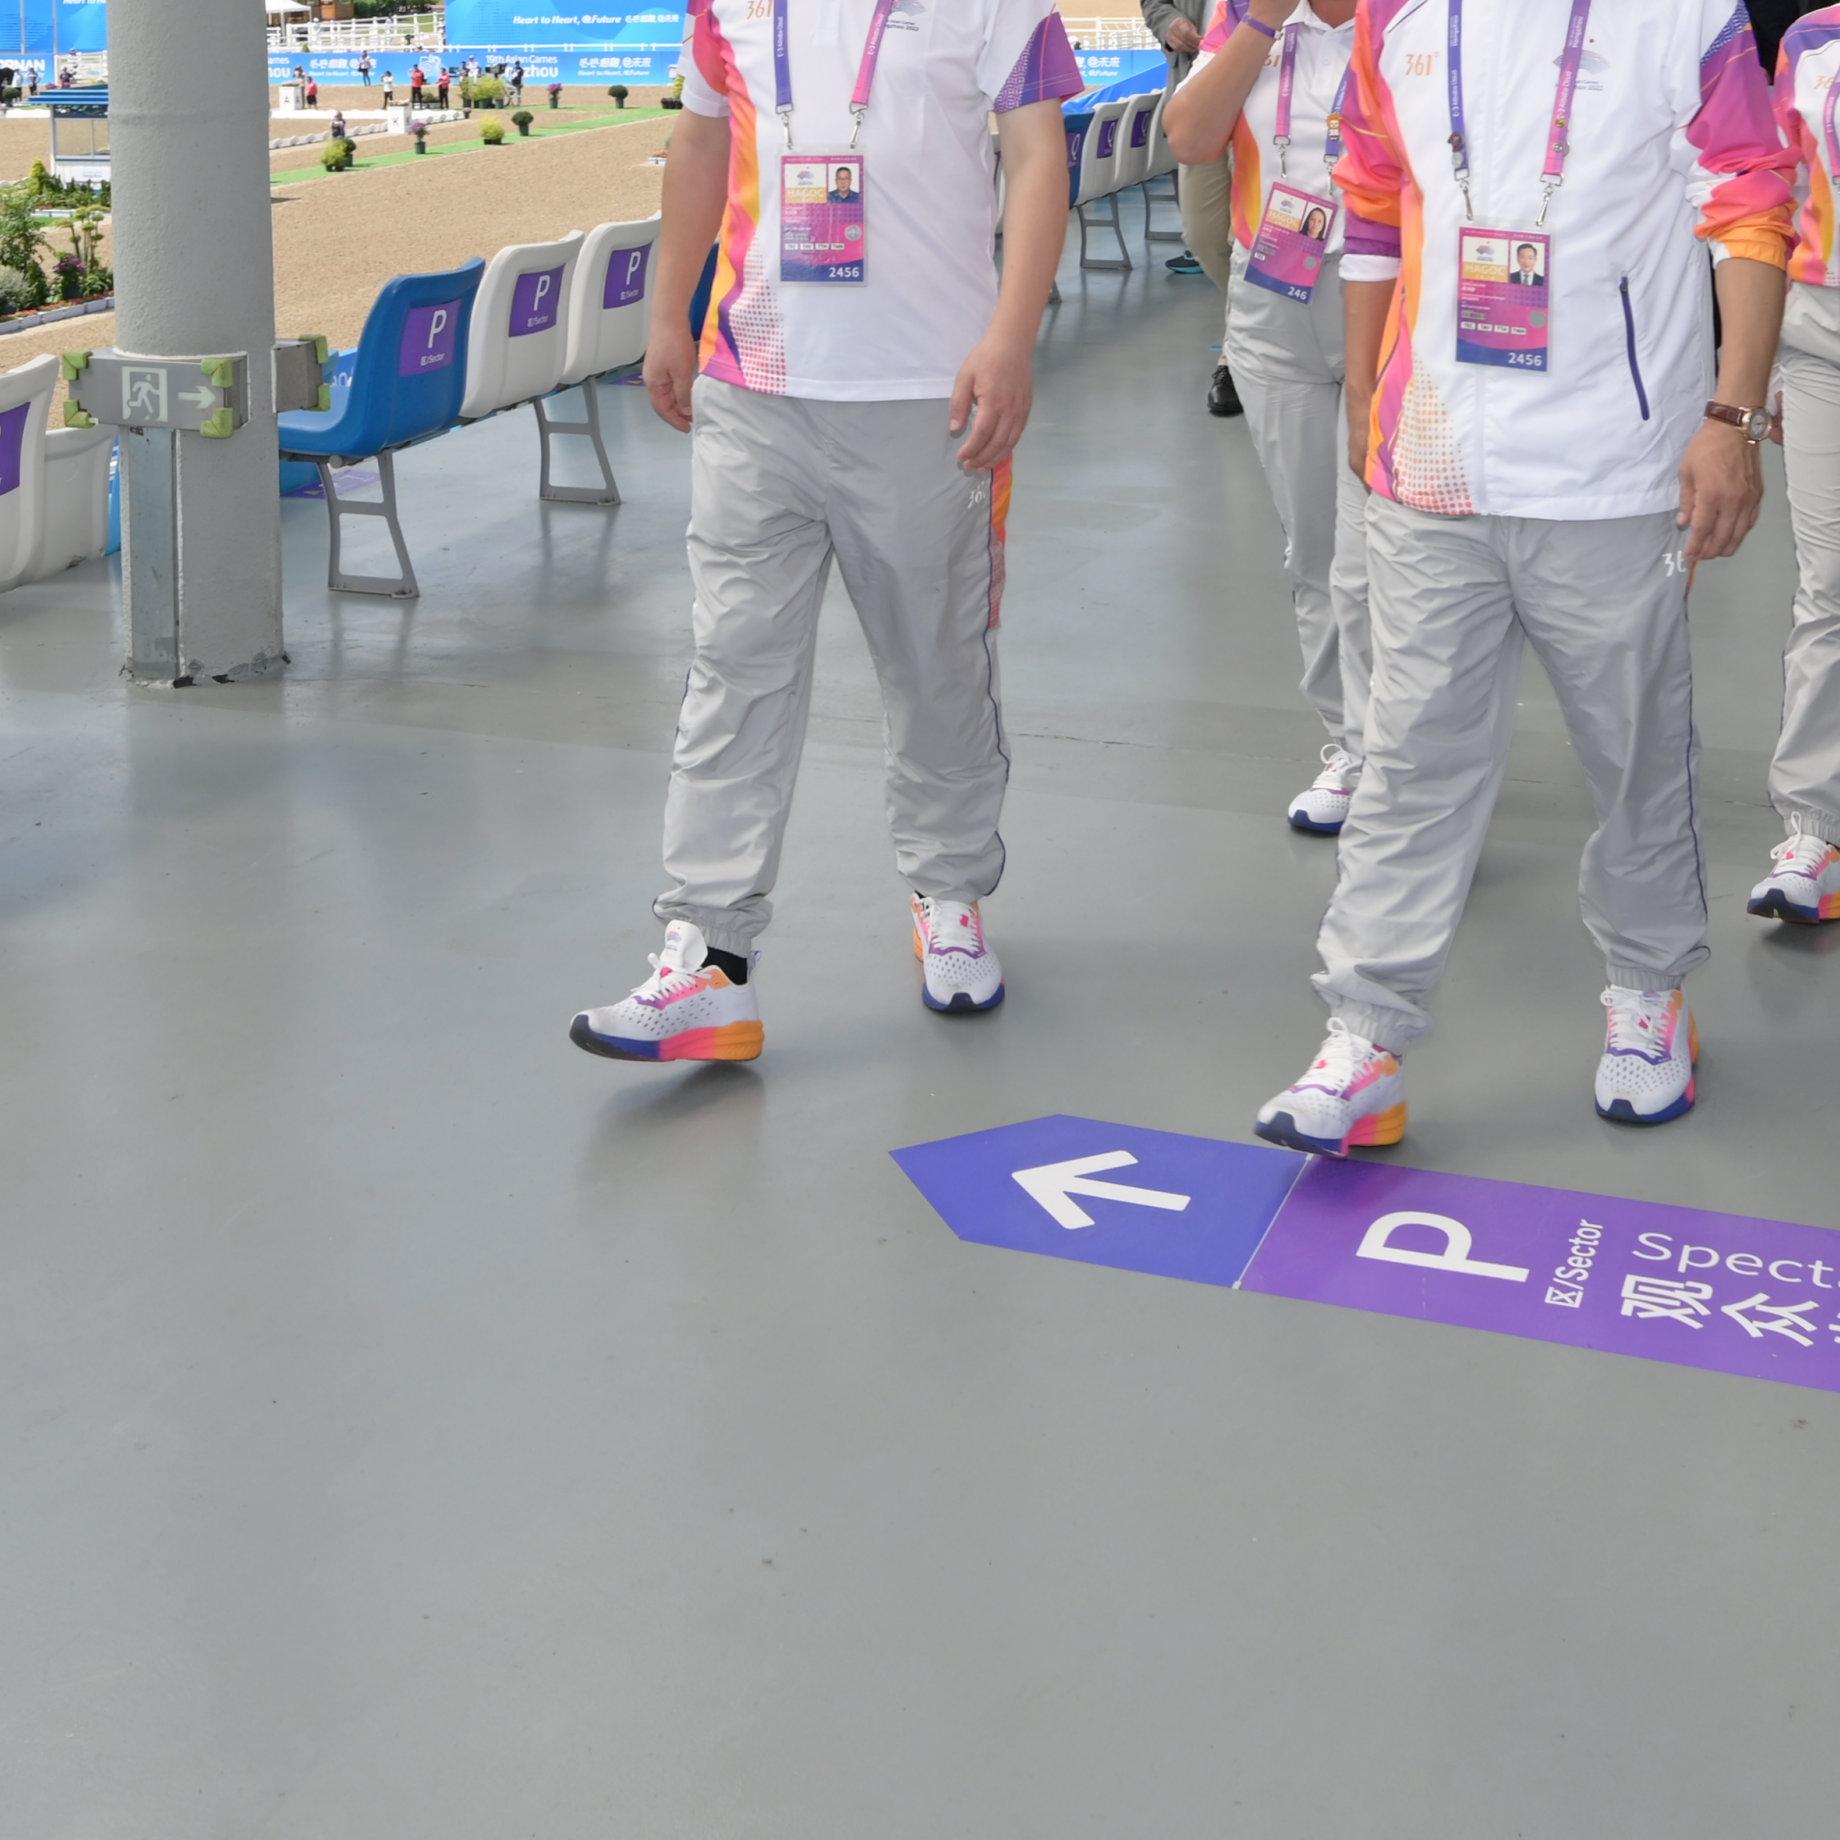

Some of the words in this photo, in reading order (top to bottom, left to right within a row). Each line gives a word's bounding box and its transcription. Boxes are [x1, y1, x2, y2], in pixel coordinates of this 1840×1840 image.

[513, 15, 539, 24] Heart
[540, 16, 550, 24] to
[581, 15, 622, 24] @Future
[530, 55, 558, 63] Games
[626, 251, 641, 285] P
[828, 266, 860, 278] 2456
[533, 274, 550, 310] P
[1287, 286, 1308, 300] 246
[427, 309, 447, 349] P
[1508, 351, 1543, 367] 2456
[1355, 1211, 1530, 1282] P
[1544, 1218, 1605, 1309] 区/Sector
